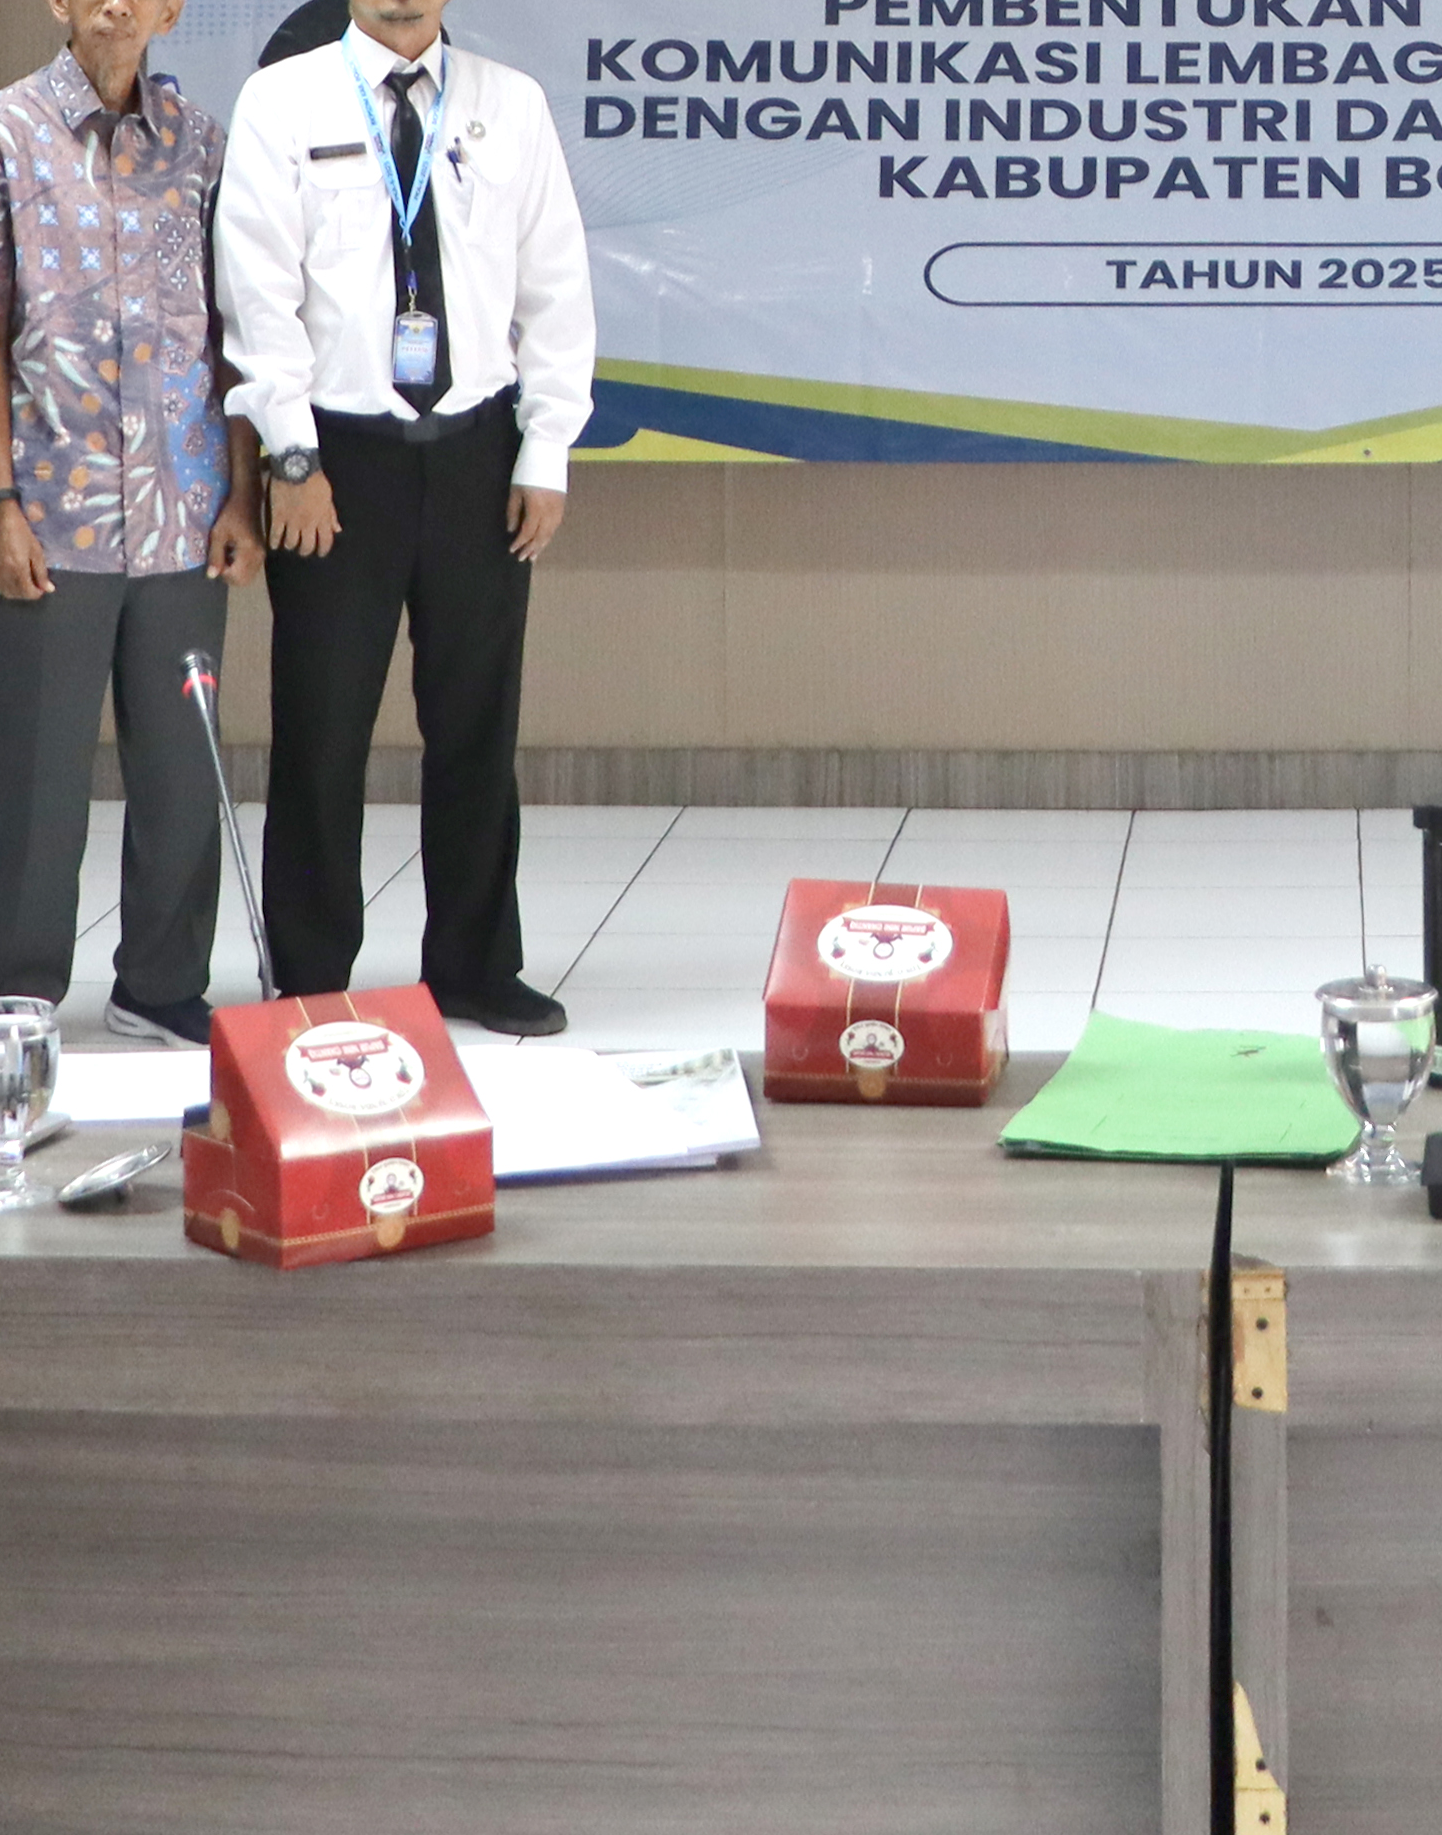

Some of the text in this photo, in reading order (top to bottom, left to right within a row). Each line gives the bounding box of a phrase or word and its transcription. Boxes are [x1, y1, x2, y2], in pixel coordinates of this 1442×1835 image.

[586, 38, 1101, 85] KOMUNIKASI
[583, 96, 920, 141] DENGAN
[944, 98, 1311, 143] INDUSTRI
[878, 155, 1360, 200] KABUPATEN
[1105, 259, 1302, 290] TAHUN
